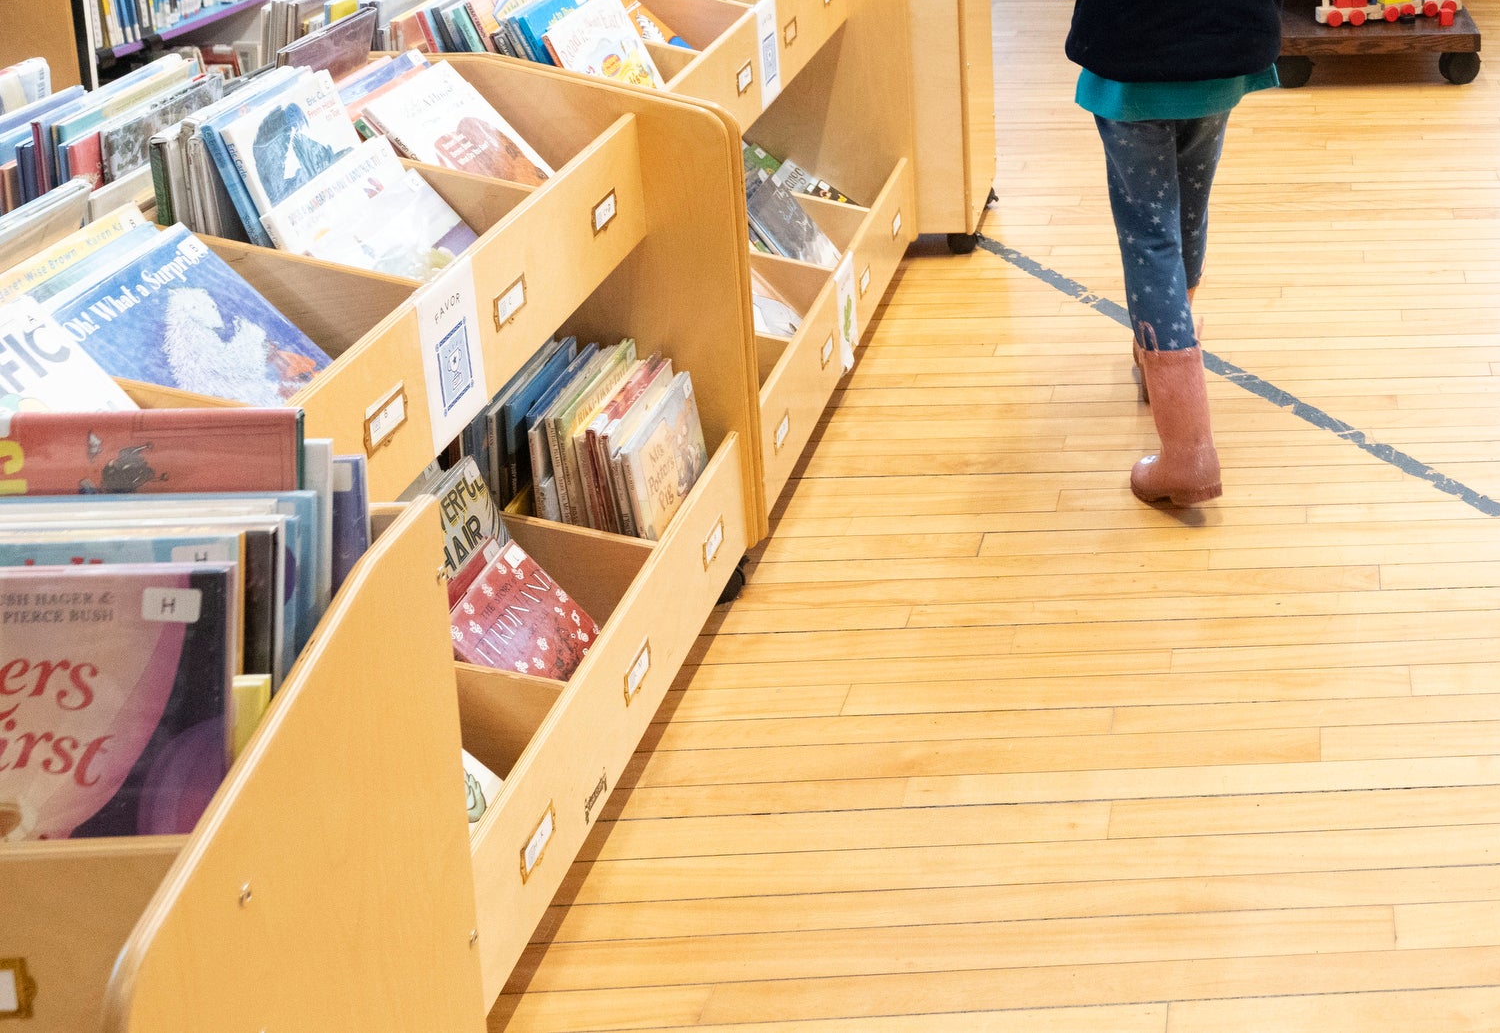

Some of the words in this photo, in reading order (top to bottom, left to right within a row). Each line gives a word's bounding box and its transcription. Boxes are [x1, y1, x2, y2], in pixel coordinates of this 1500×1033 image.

[24, 263, 48, 284] Wise
[48, 247, 79, 271] Brown
[86, 228, 113, 247] Karen
[62, 311, 102, 343] Oh!
[88, 285, 142, 322] What
[135, 284, 150, 298] a
[433, 291, 462, 326] FAVOR
[439, 473, 486, 525] ERFUL
[35, 591, 96, 606] HAGER
[161, 597, 176, 615] H
[3, 610, 64, 624] PIERCE
[69, 609, 115, 623] BUSH
